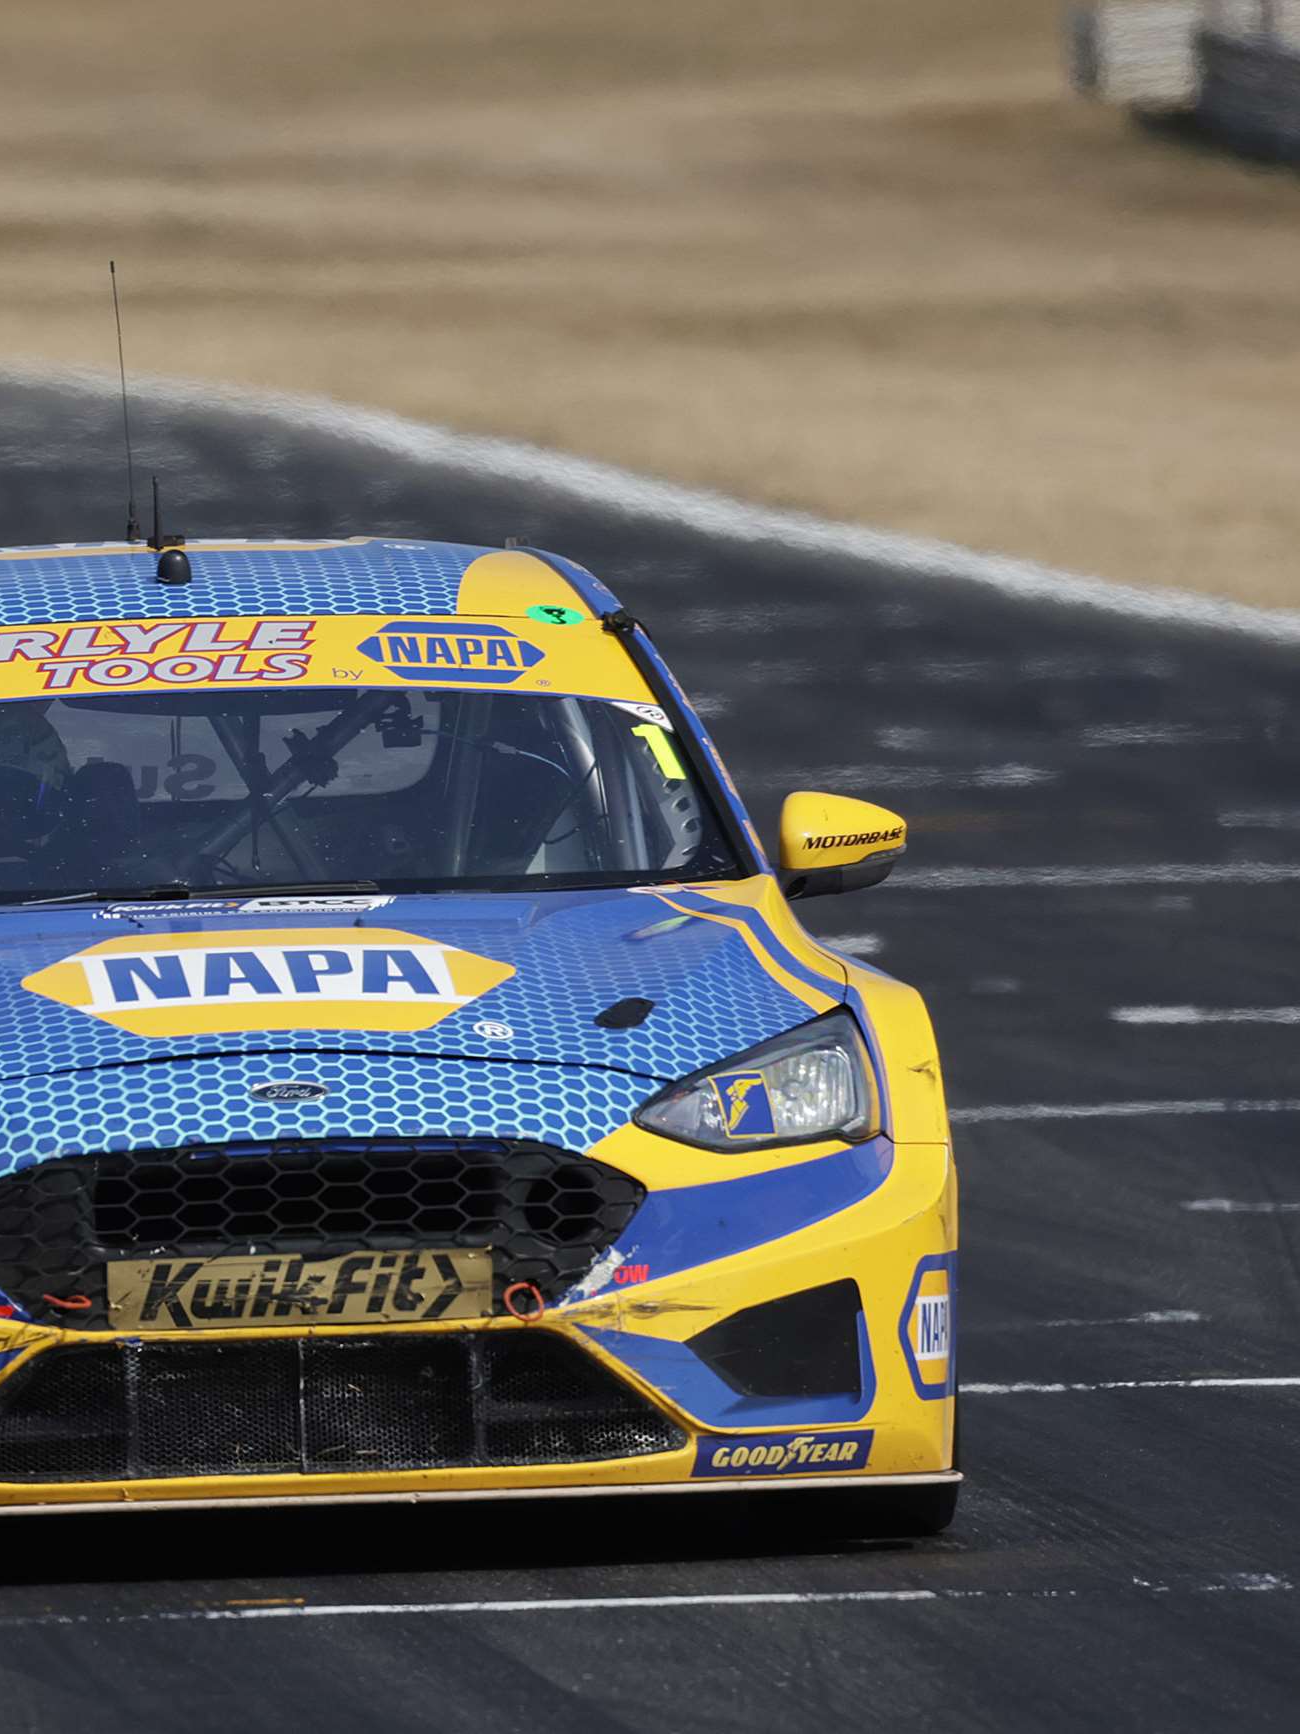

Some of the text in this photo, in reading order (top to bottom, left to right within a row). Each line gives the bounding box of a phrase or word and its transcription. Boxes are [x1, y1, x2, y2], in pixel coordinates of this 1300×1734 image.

[38, 653, 312, 690] TOOLS
[331, 635, 518, 681] by NAPA
[630, 723, 687, 780] 1
[802, 826, 904, 851] MOTORBASE
[102, 949, 441, 1004] NAPA
[612, 1263, 651, 1285] OW
